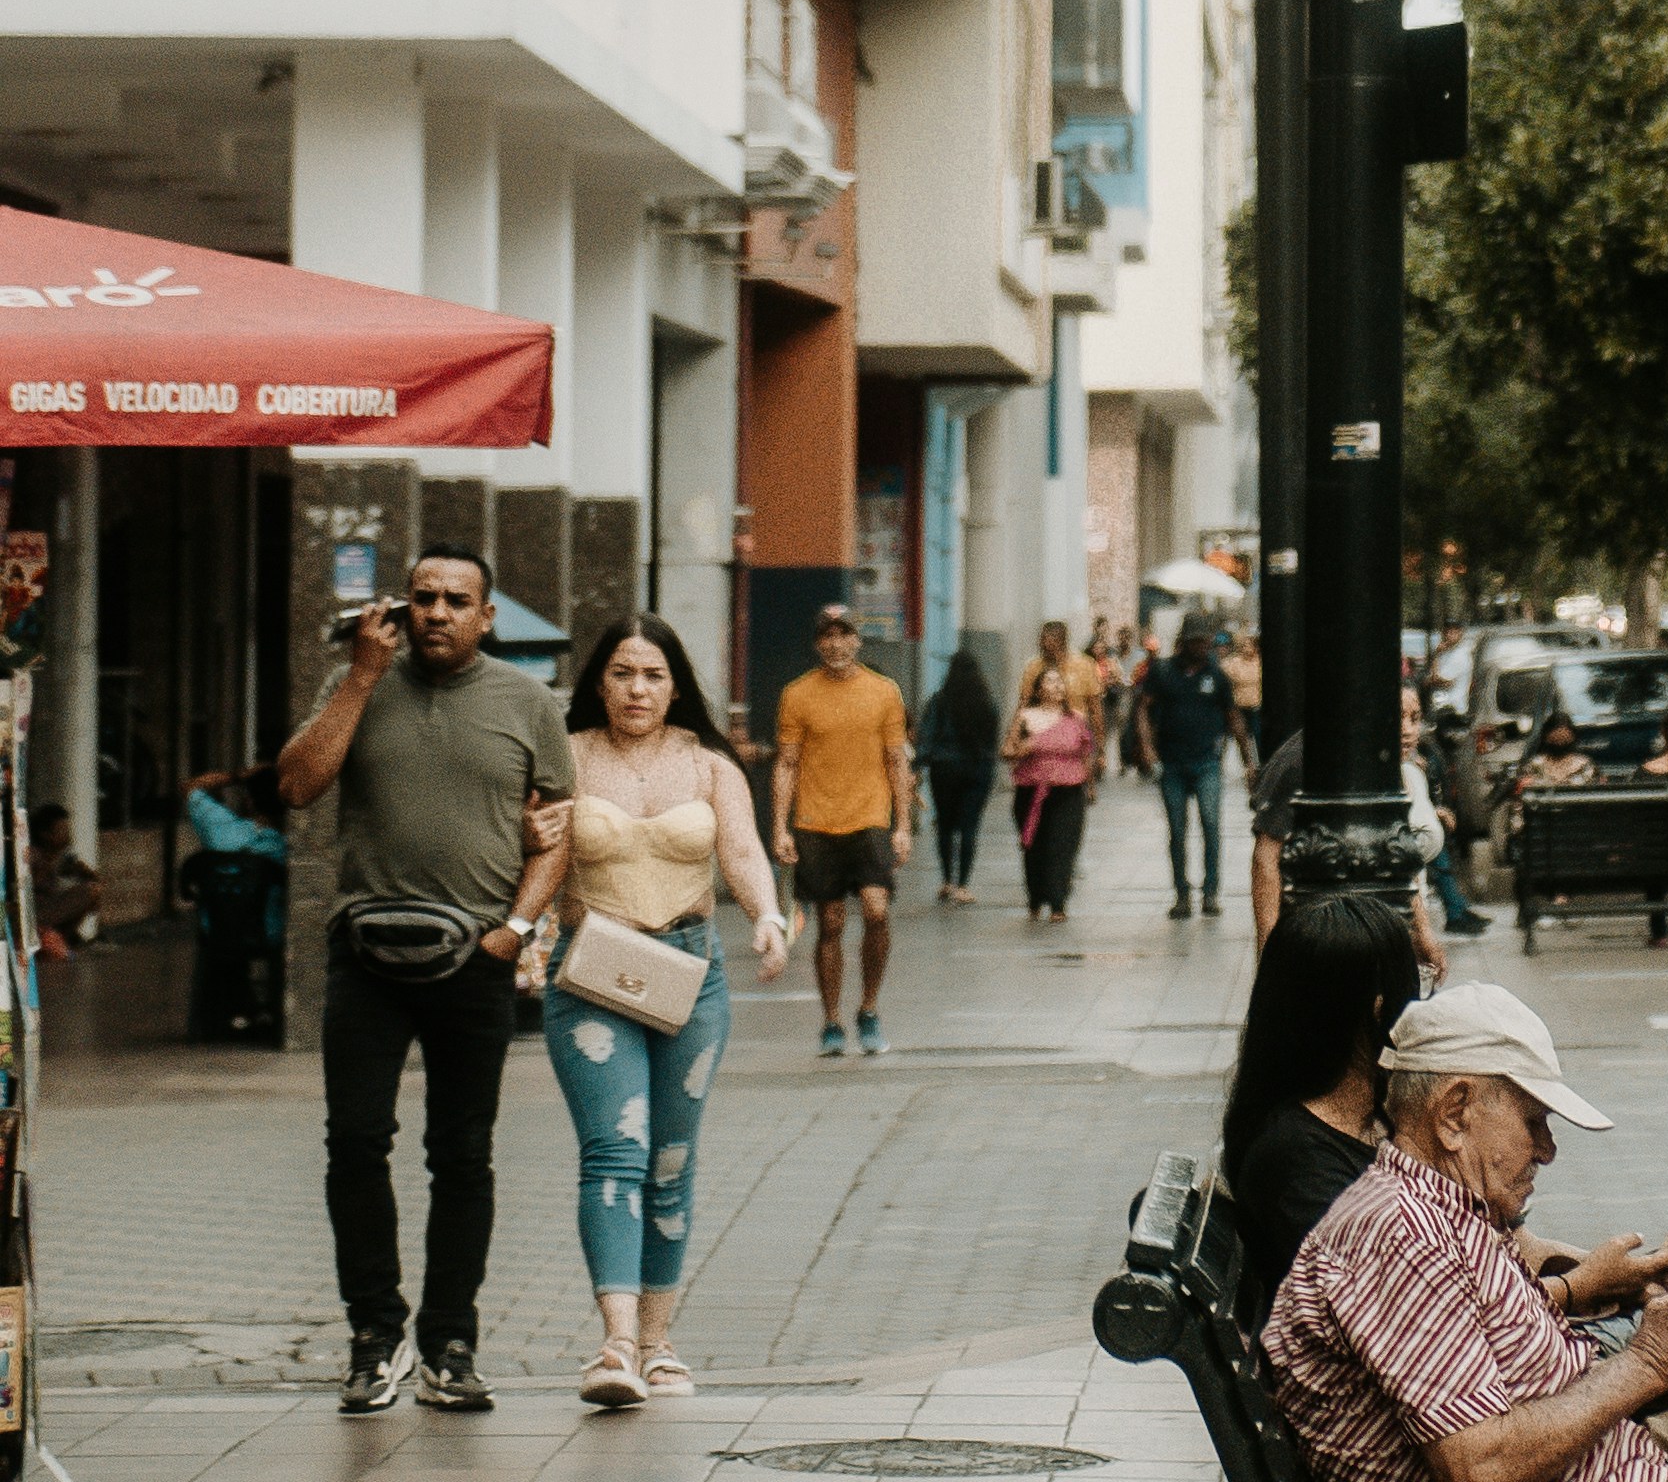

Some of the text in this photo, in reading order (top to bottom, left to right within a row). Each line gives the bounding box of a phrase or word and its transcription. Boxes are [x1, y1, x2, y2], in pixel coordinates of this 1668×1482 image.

[12, 380, 398, 417] GIGAS VELOCIDAD COBERTURA
